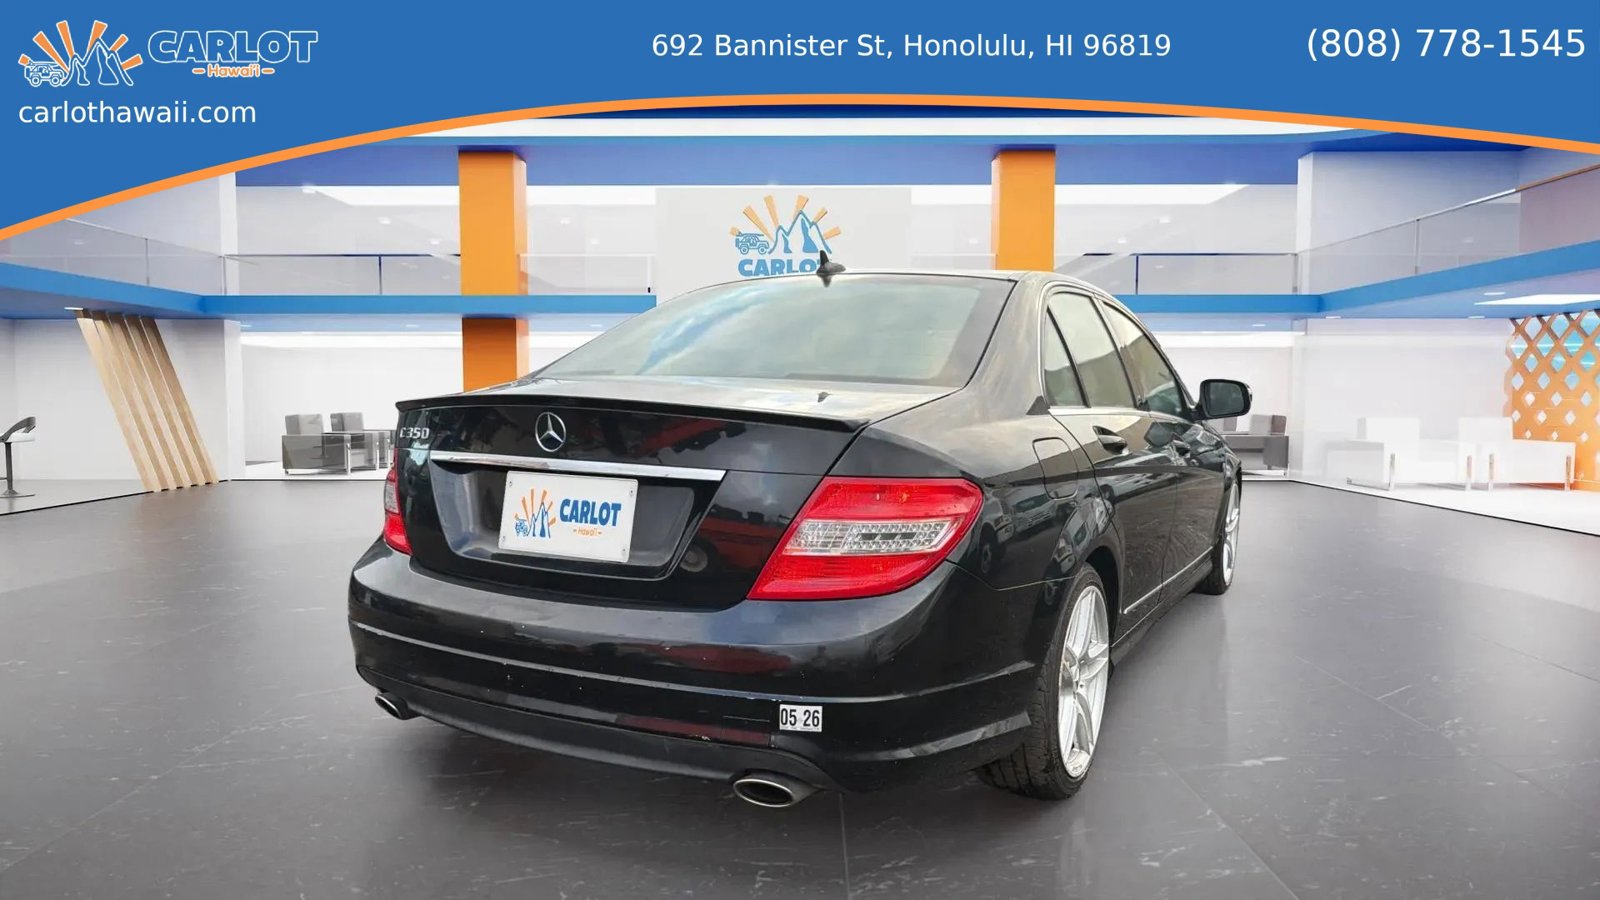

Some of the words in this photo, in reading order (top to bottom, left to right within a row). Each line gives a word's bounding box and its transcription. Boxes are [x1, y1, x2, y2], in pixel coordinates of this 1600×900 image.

[738, 258, 822, 277] CARLO
[400, 427, 430, 439] C350
[560, 498, 622, 527] CARLOT
[781, 708, 797, 726] 05
[803, 709, 820, 727] 26
